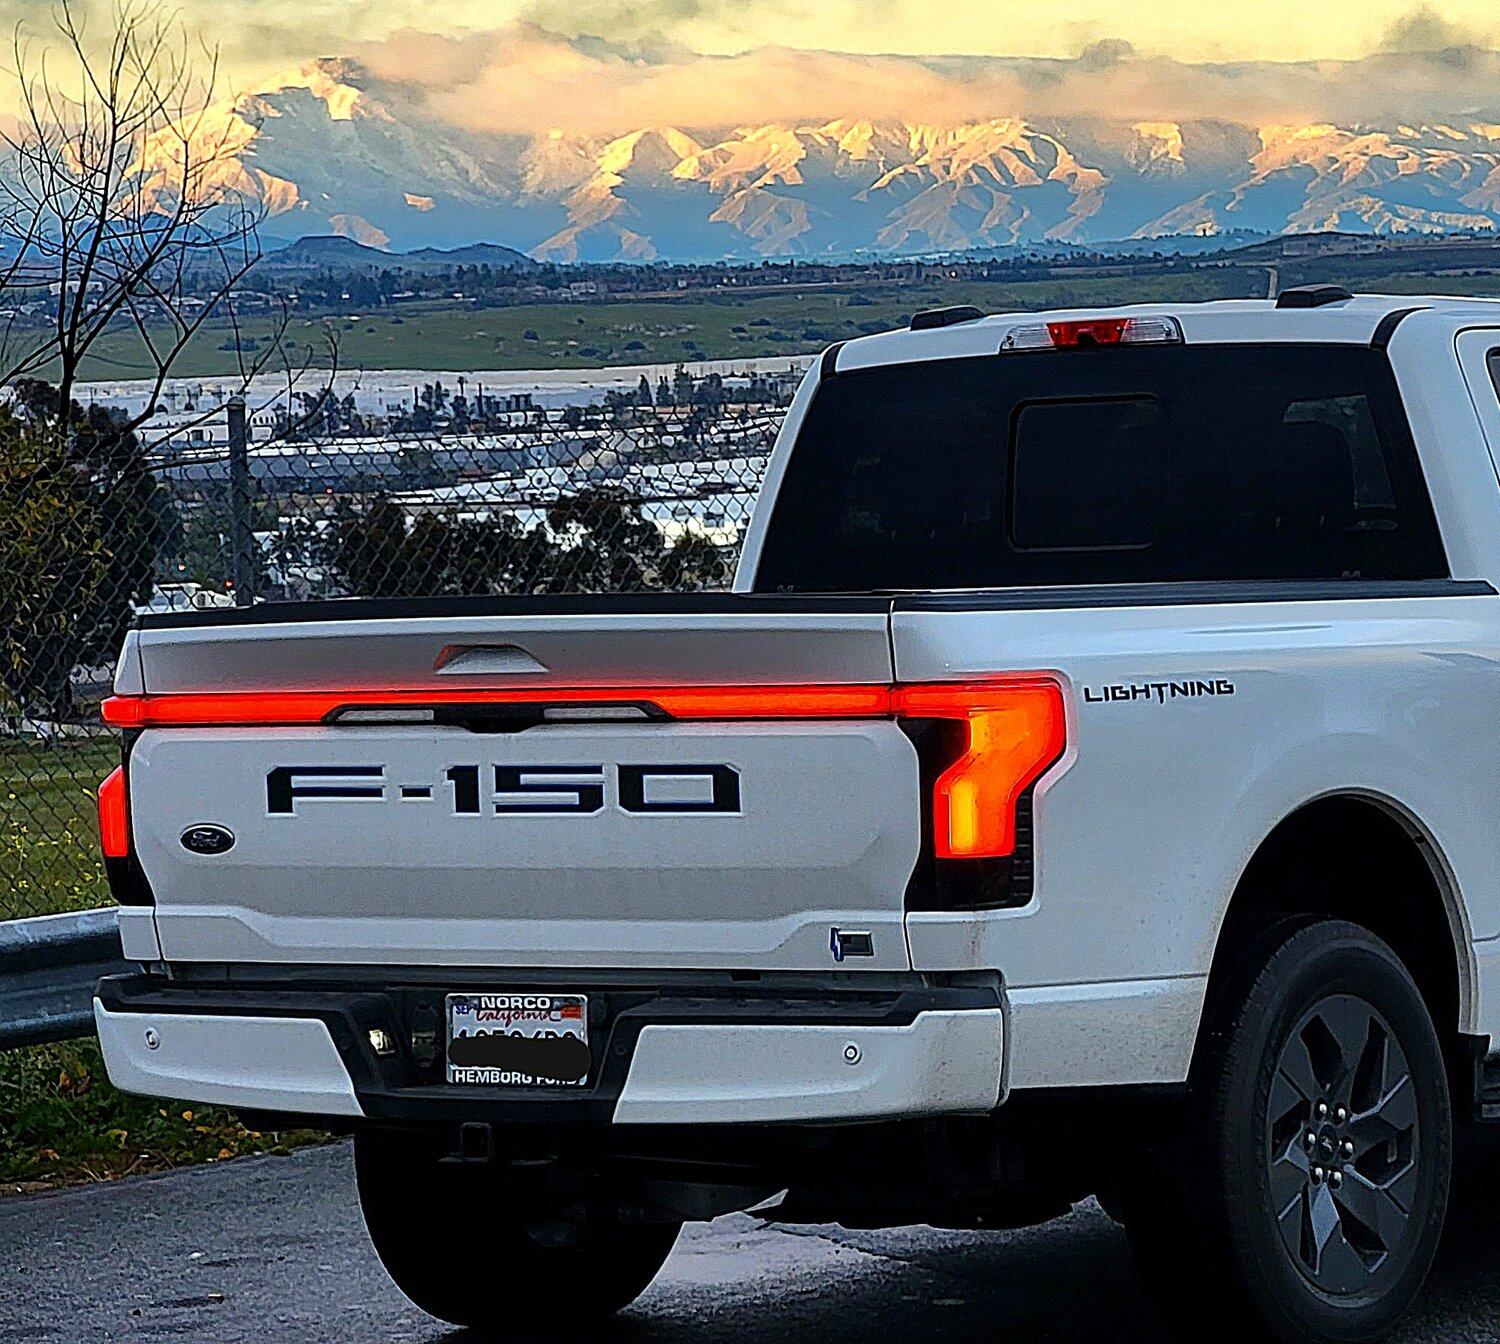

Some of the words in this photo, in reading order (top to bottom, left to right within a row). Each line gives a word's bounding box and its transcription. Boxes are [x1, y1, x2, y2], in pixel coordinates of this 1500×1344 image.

[1083, 679, 1235, 704] LIGHTNING
[265, 762, 743, 816] F-150
[481, 996, 551, 1009] NORCO
